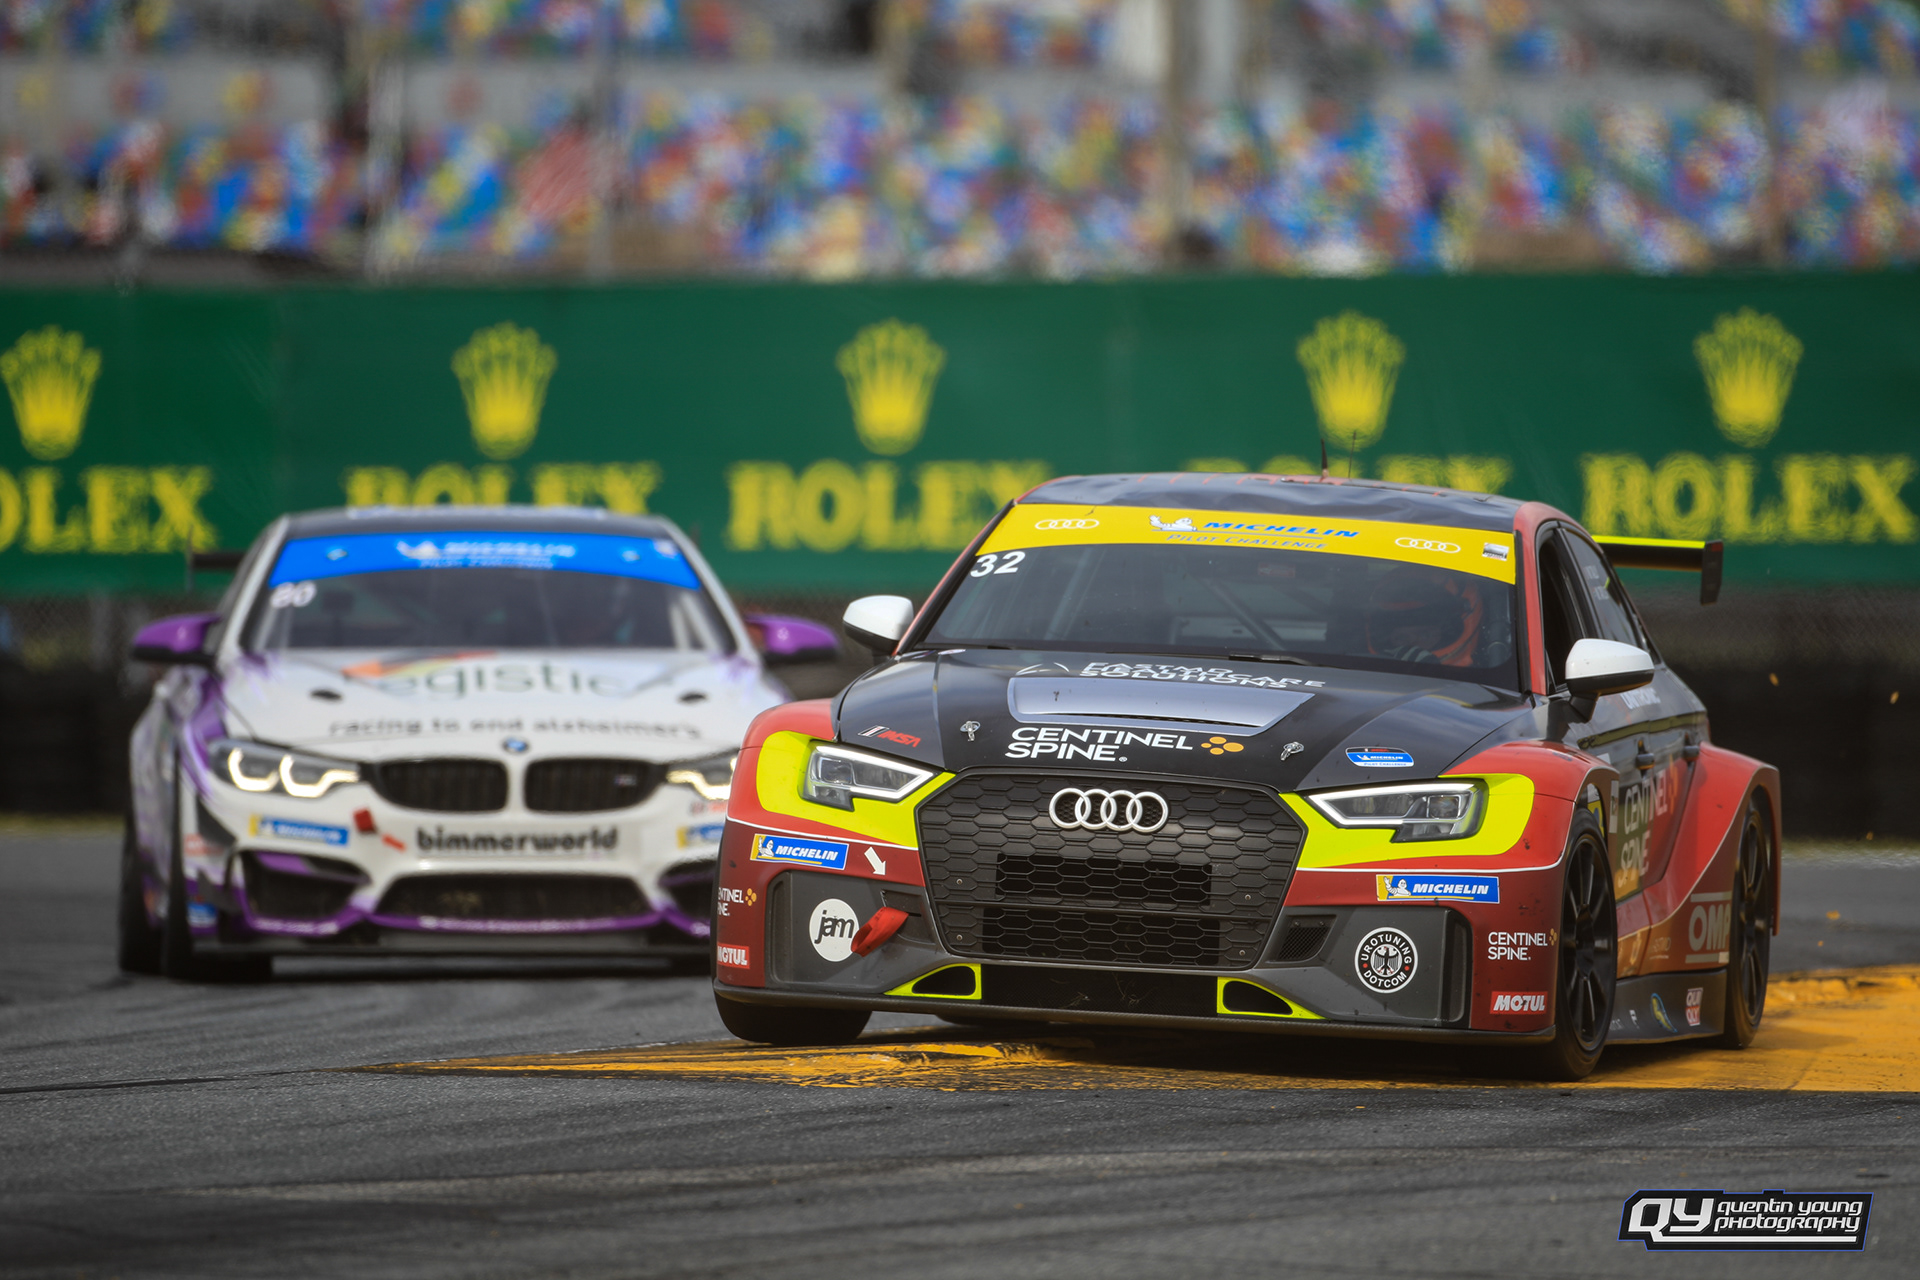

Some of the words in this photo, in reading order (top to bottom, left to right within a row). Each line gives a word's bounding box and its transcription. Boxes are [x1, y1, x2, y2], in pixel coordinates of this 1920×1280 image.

[1581, 452, 1917, 544] ROLEX
[1203, 522, 1359, 537] MICHELIN
[1166, 534, 1220, 543] PILOT
[1225, 536, 1328, 549] CHALLENGE
[970, 551, 1026, 578] 32
[1079, 671, 1288, 688] SOLUTIONS
[877, 730, 921, 747] IMSA
[1011, 727, 1194, 750] CENTINEL
[416, 825, 618, 850] bimmerworld
[775, 844, 839, 861] MICHELIN
[1412, 883, 1489, 895] MICHELIN
[814, 909, 855, 944] jam
[1688, 904, 1731, 952] OMP
[1488, 932, 1548, 947] CENTINEL
[718, 946, 748, 966] MOTUL
[1361, 934, 1412, 964] UROTUNING
[1363, 970, 1407, 988] DOTCOM
[1493, 995, 1545, 1012] MOTUL
